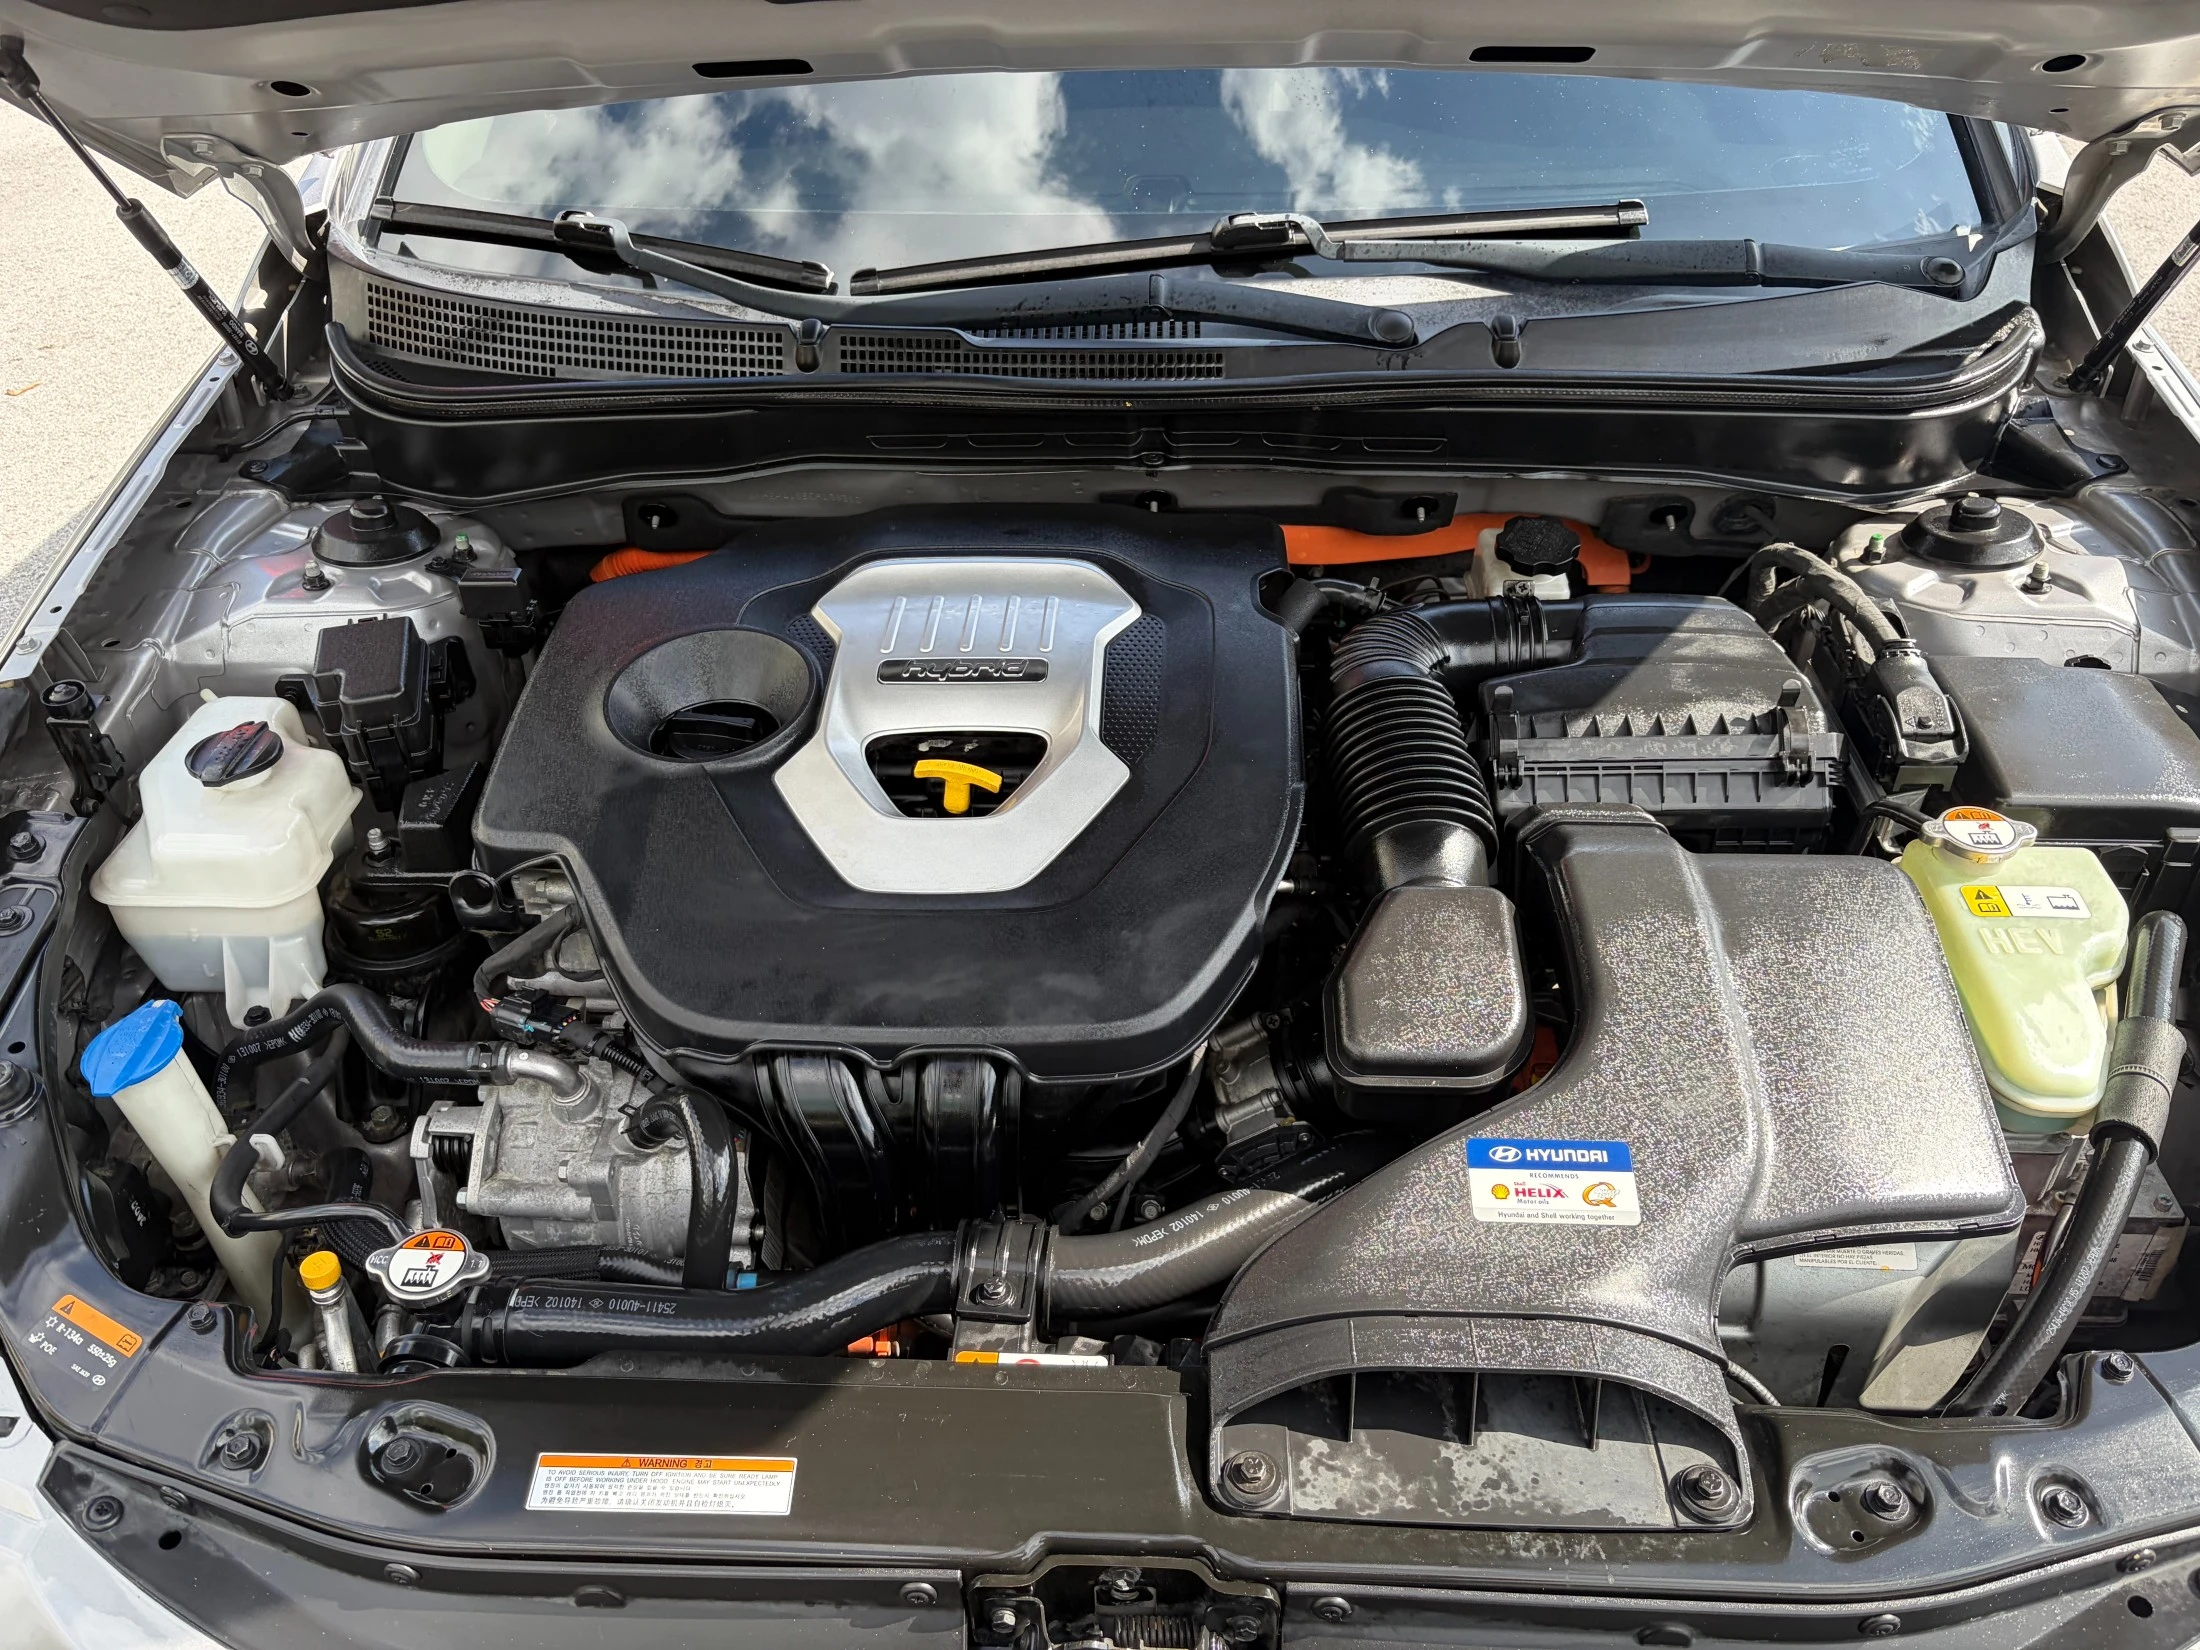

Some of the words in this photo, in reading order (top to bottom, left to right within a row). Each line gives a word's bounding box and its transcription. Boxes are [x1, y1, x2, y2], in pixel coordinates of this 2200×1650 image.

[902, 659, 1029, 681] hybrid
[1979, 928, 2064, 955] HEV
[237, 1042, 262, 1058] 131007
[1526, 1149, 1609, 1163] HYUNDAI
[1515, 1188, 1566, 1199] HELIX
[1169, 1210, 1204, 1232] 140102
[1498, 1211, 1525, 1220] Hyundai
[1559, 1213, 1586, 1221] working
[1588, 1214, 1615, 1222] together
[370, 1256, 389, 1264] HCC
[516, 1295, 541, 1308] >EPD
[545, 1296, 583, 1308] 140102
[608, 1298, 677, 1314] 25411-4U010
[40, 1341, 58, 1355] POE
[56, 1323, 84, 1346] R-134a
[87, 1344, 118, 1368] 550±25g
[639, 1458, 688, 1469] WARNING
[694, 1459, 713, 1469] 경고
